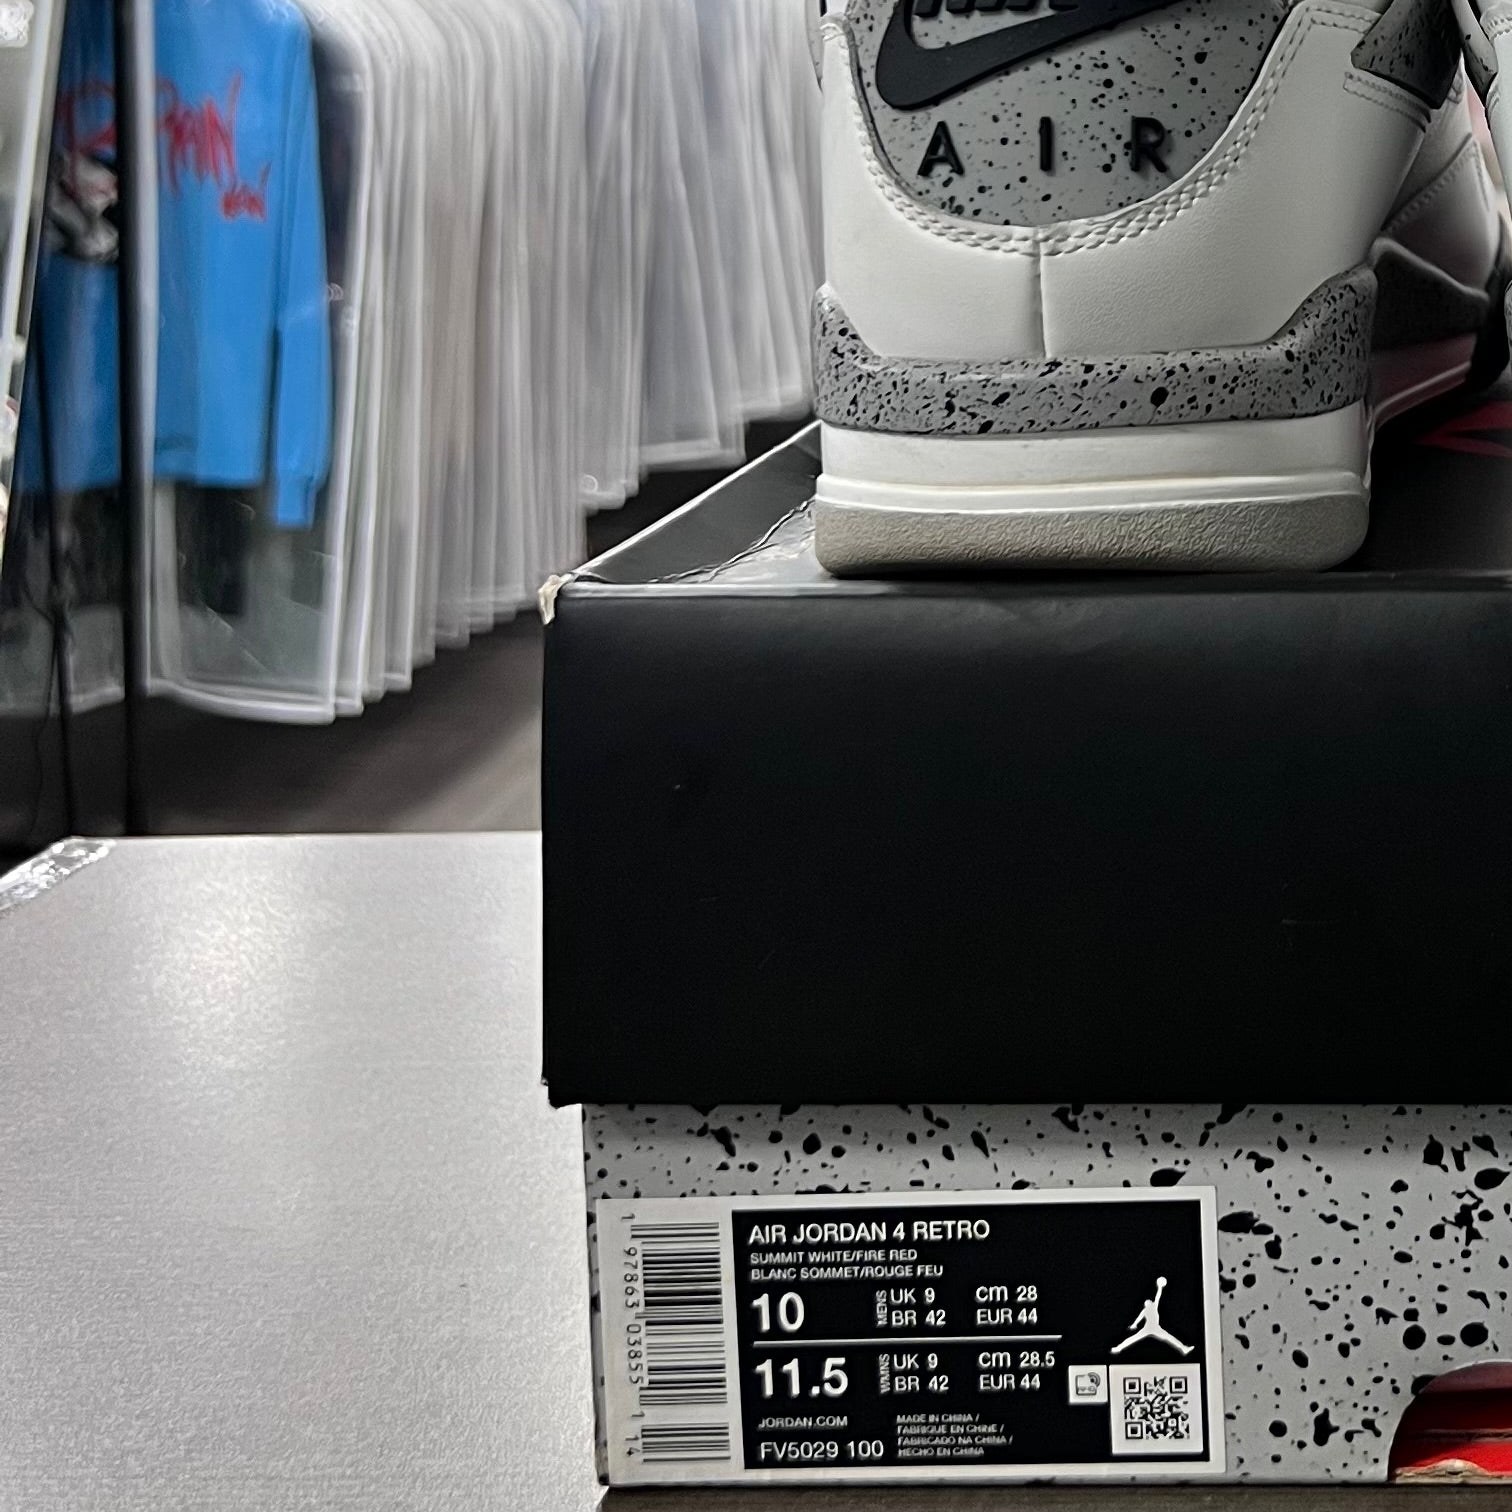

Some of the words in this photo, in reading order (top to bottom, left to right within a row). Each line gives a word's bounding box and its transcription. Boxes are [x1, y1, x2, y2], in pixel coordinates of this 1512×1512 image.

[917, 116, 1169, 178] AIR
[748, 1224, 787, 1245] AIR
[793, 1222, 887, 1244] JORDAN
[892, 1222, 905, 1240] 4
[912, 1219, 990, 1241] RETRO
[750, 1251, 804, 1265] SUMMIT
[808, 1249, 886, 1263] WHITE/FIRE
[889, 1249, 918, 1261] RED
[623, 1246, 640, 1309] 97863
[750, 1267, 797, 1281] BLANC
[800, 1265, 914, 1279] SOMMET/ROUGE
[916, 1265, 944, 1277] FEU
[890, 1288, 916, 1304] UK
[924, 1287, 935, 1304] 9
[1016, 1285, 1038, 1302] 28
[752, 1291, 805, 1333] 10
[875, 1289, 888, 1327] MENS
[976, 1308, 1013, 1325] EUR
[1017, 1308, 1038, 1325] 44
[891, 1310, 917, 1327] BR
[925, 1309, 946, 1327] 42
[626, 1323, 645, 1385] 03855
[893, 1353, 920, 1370] UK
[927, 1353, 938, 1370] 9
[1019, 1351, 1055, 1368] 28.5
[755, 1357, 849, 1399] 11.5
[879, 1353, 891, 1394] WMNS
[894, 1376, 920, 1392] BR
[928, 1375, 949, 1392] 42
[979, 1374, 1016, 1391] EUR
[1020, 1374, 1041, 1391] 44
[758, 1416, 848, 1430] JORDAN.COM
[897, 1414, 926, 1423] MADE
[929, 1414, 939, 1422] IN
[941, 1413, 973, 1422] CHINA
[950, 1424, 964, 1433] EN
[958, 1435, 973, 1444] NA
[760, 1441, 839, 1461] FV5029
[847, 1440, 884, 1458] 100
[898, 1447, 935, 1457] HECHO
[936, 1447, 951, 1456] EN
